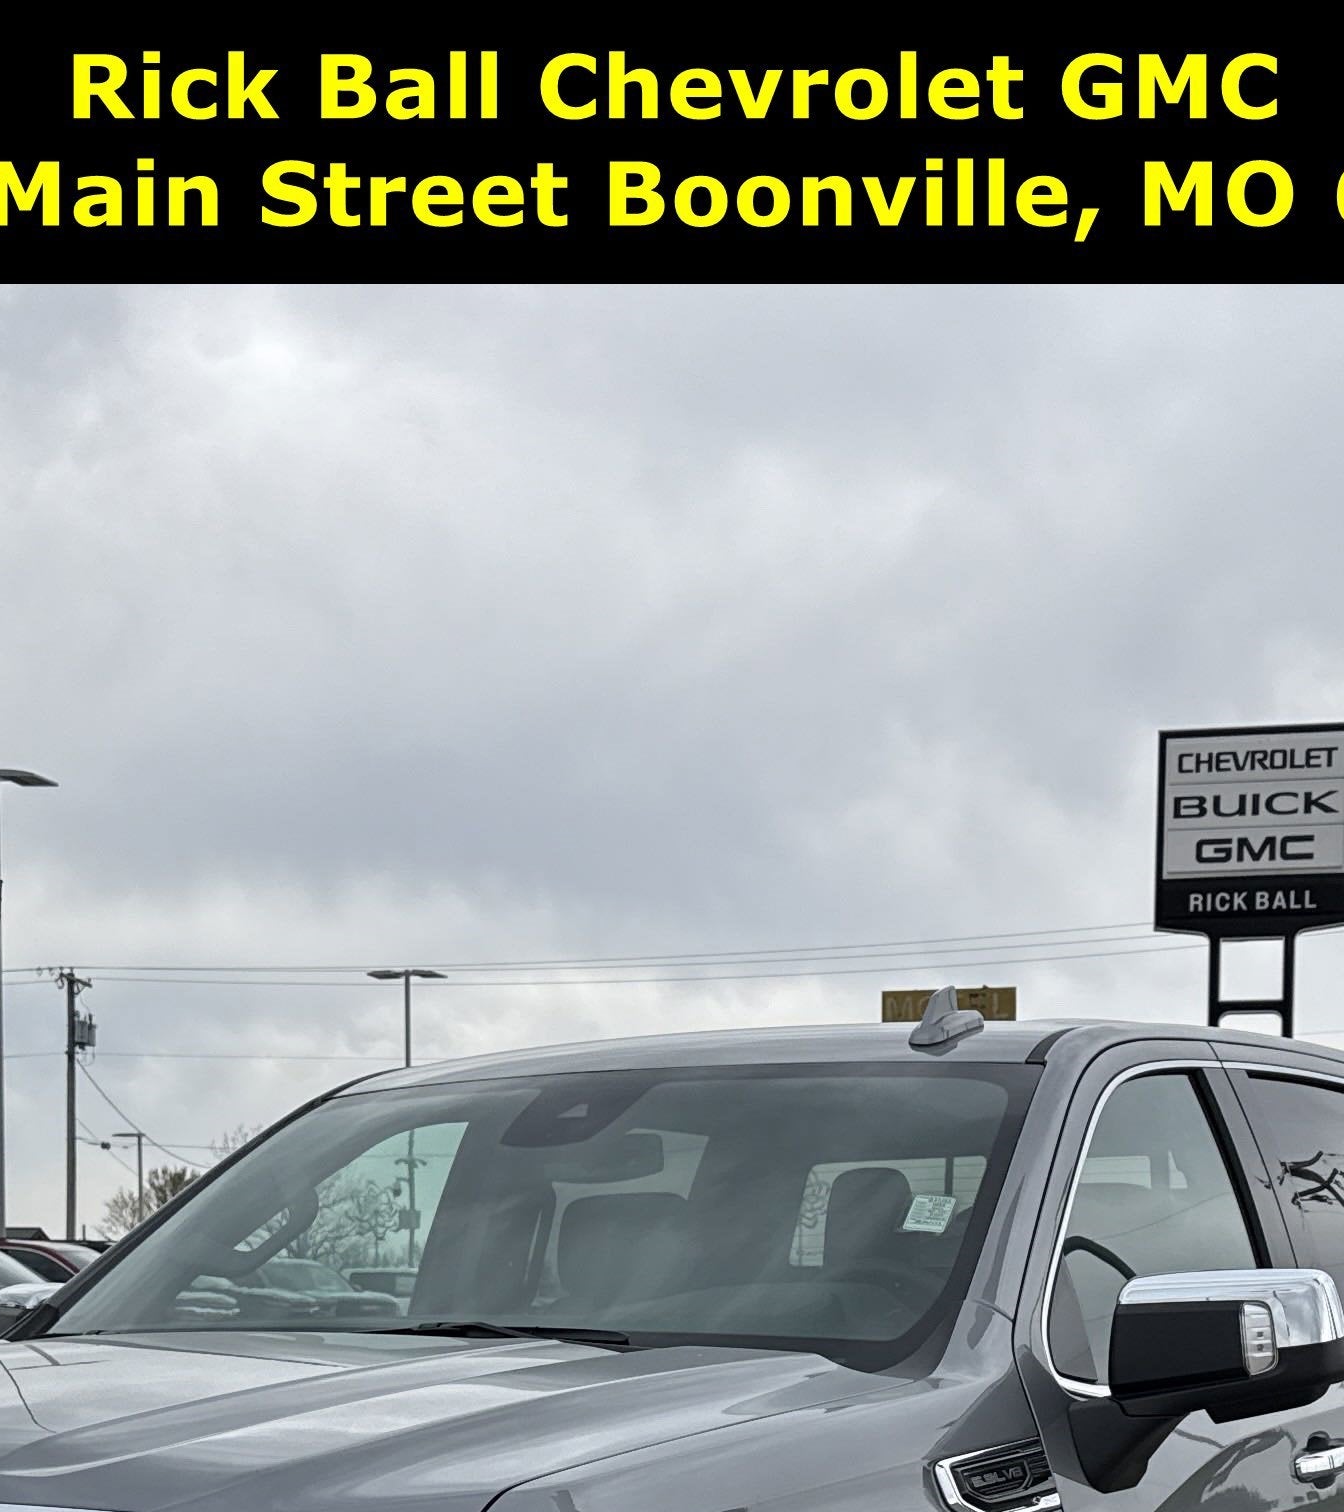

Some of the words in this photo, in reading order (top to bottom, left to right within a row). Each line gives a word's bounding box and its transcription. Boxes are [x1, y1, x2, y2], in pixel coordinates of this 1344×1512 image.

[1177, 746, 1339, 774] CHEVROLET
[1173, 789, 1340, 819] BUICK
[1195, 834, 1315, 863] GMC
[1188, 892, 1248, 912] RICK
[1255, 889, 1317, 910] BALL
